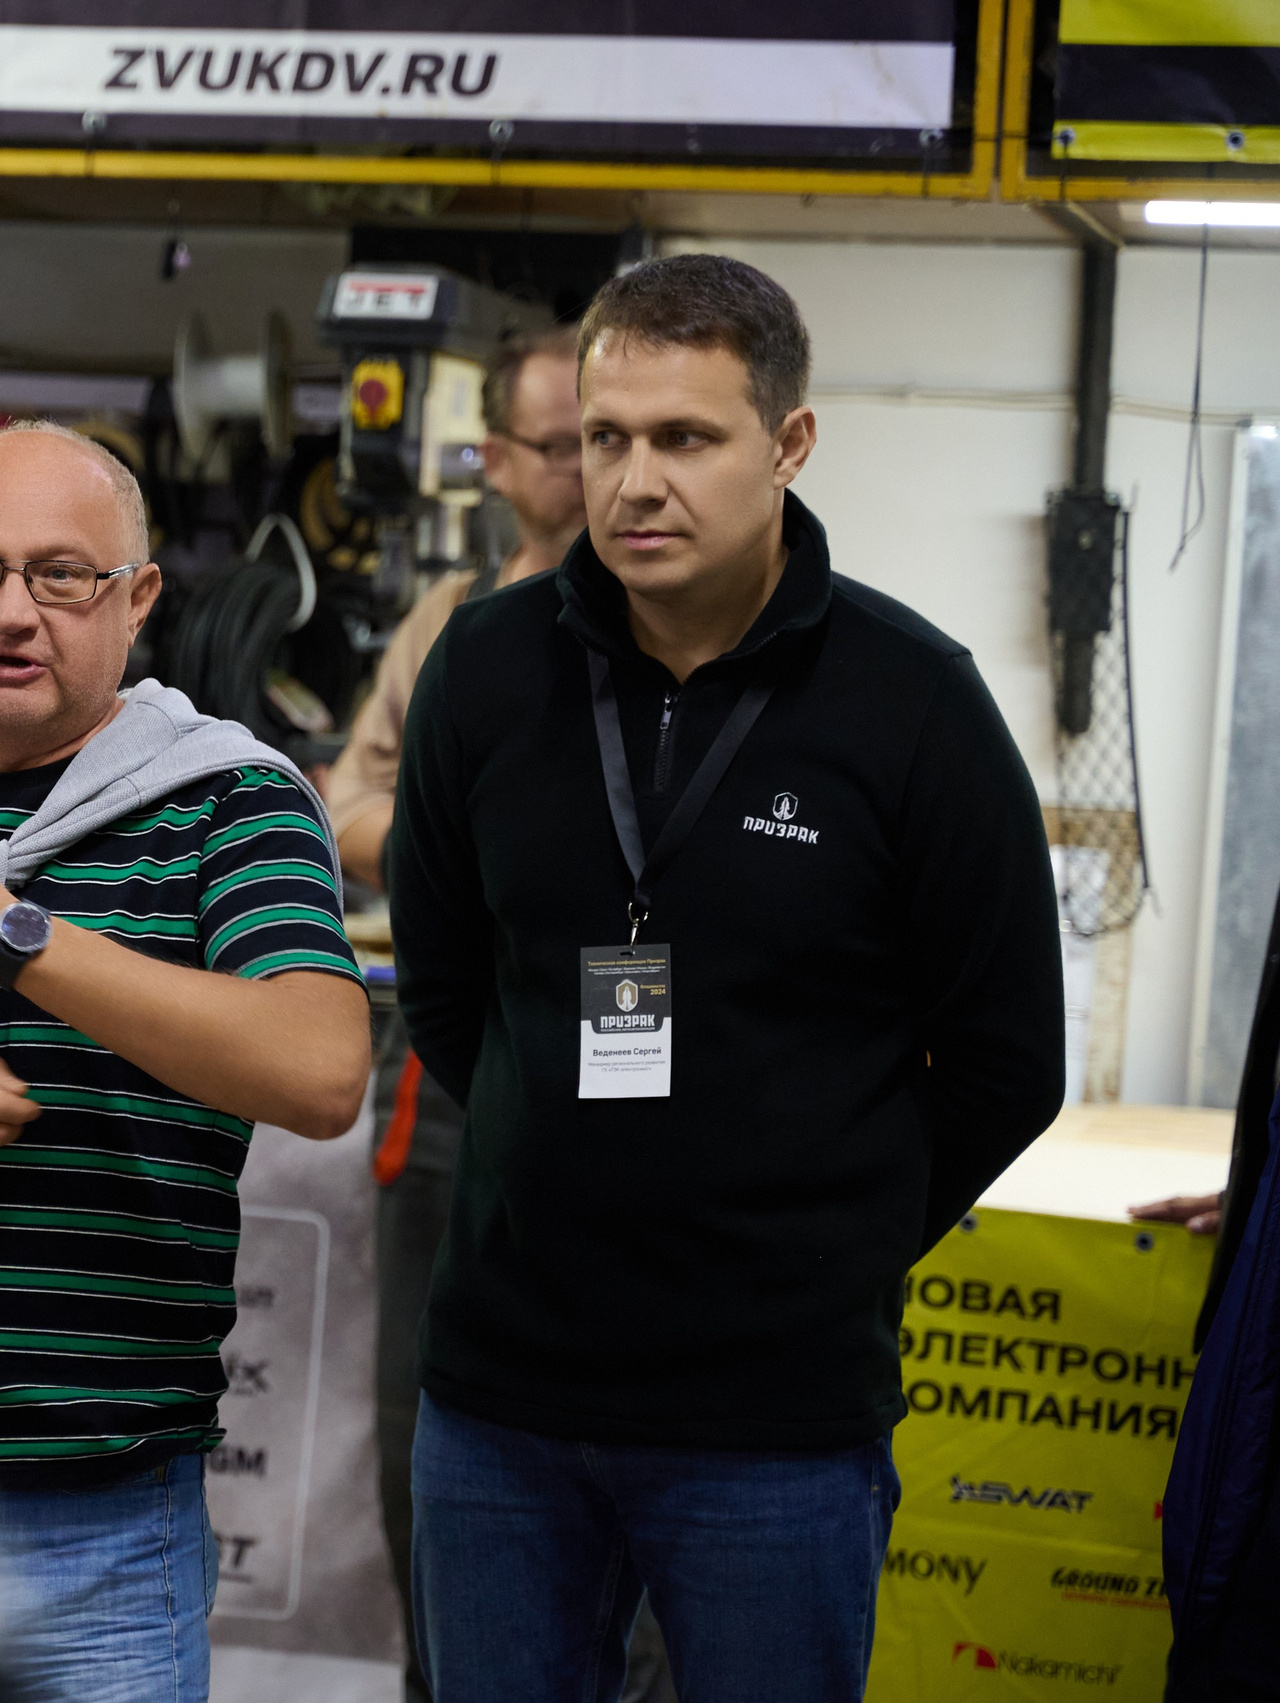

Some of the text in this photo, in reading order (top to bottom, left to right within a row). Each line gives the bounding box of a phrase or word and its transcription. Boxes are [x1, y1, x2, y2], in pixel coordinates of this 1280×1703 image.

[105, 48, 498, 96] ZVUKDV.RU
[743, 816, 819, 844] ПРИЗРАК
[650, 988, 666, 996] 2024
[600, 1014, 655, 1028] ПРИЗРАК
[633, 1047, 662, 1057] Сергей
[898, 1326, 1196, 1390] ЭЛЕКТРОНН
[908, 1380, 1179, 1440] ОМПАНИЯ
[1051, 1566, 1140, 1594] GROUND
[998, 1650, 1122, 1686] Nakamichi
